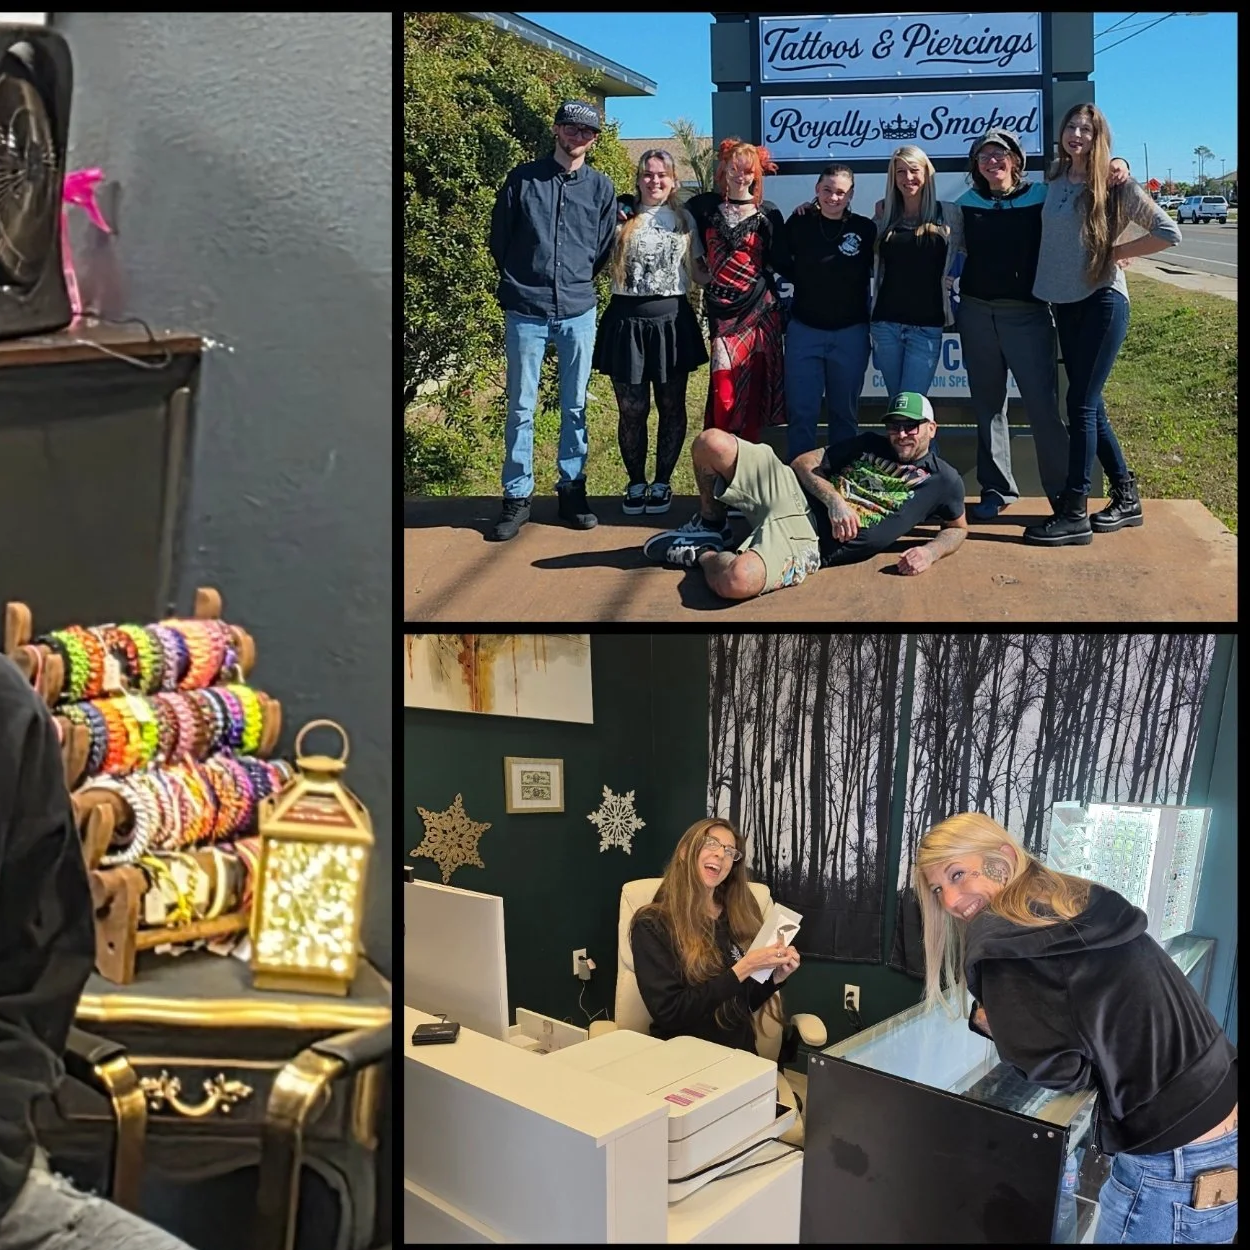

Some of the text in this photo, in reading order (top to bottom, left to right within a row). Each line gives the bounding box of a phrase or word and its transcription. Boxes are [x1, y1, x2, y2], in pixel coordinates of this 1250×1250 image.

[764, 23, 1037, 71] Tattoos & Piercings
[766, 106, 1039, 149] Royally Smoked
